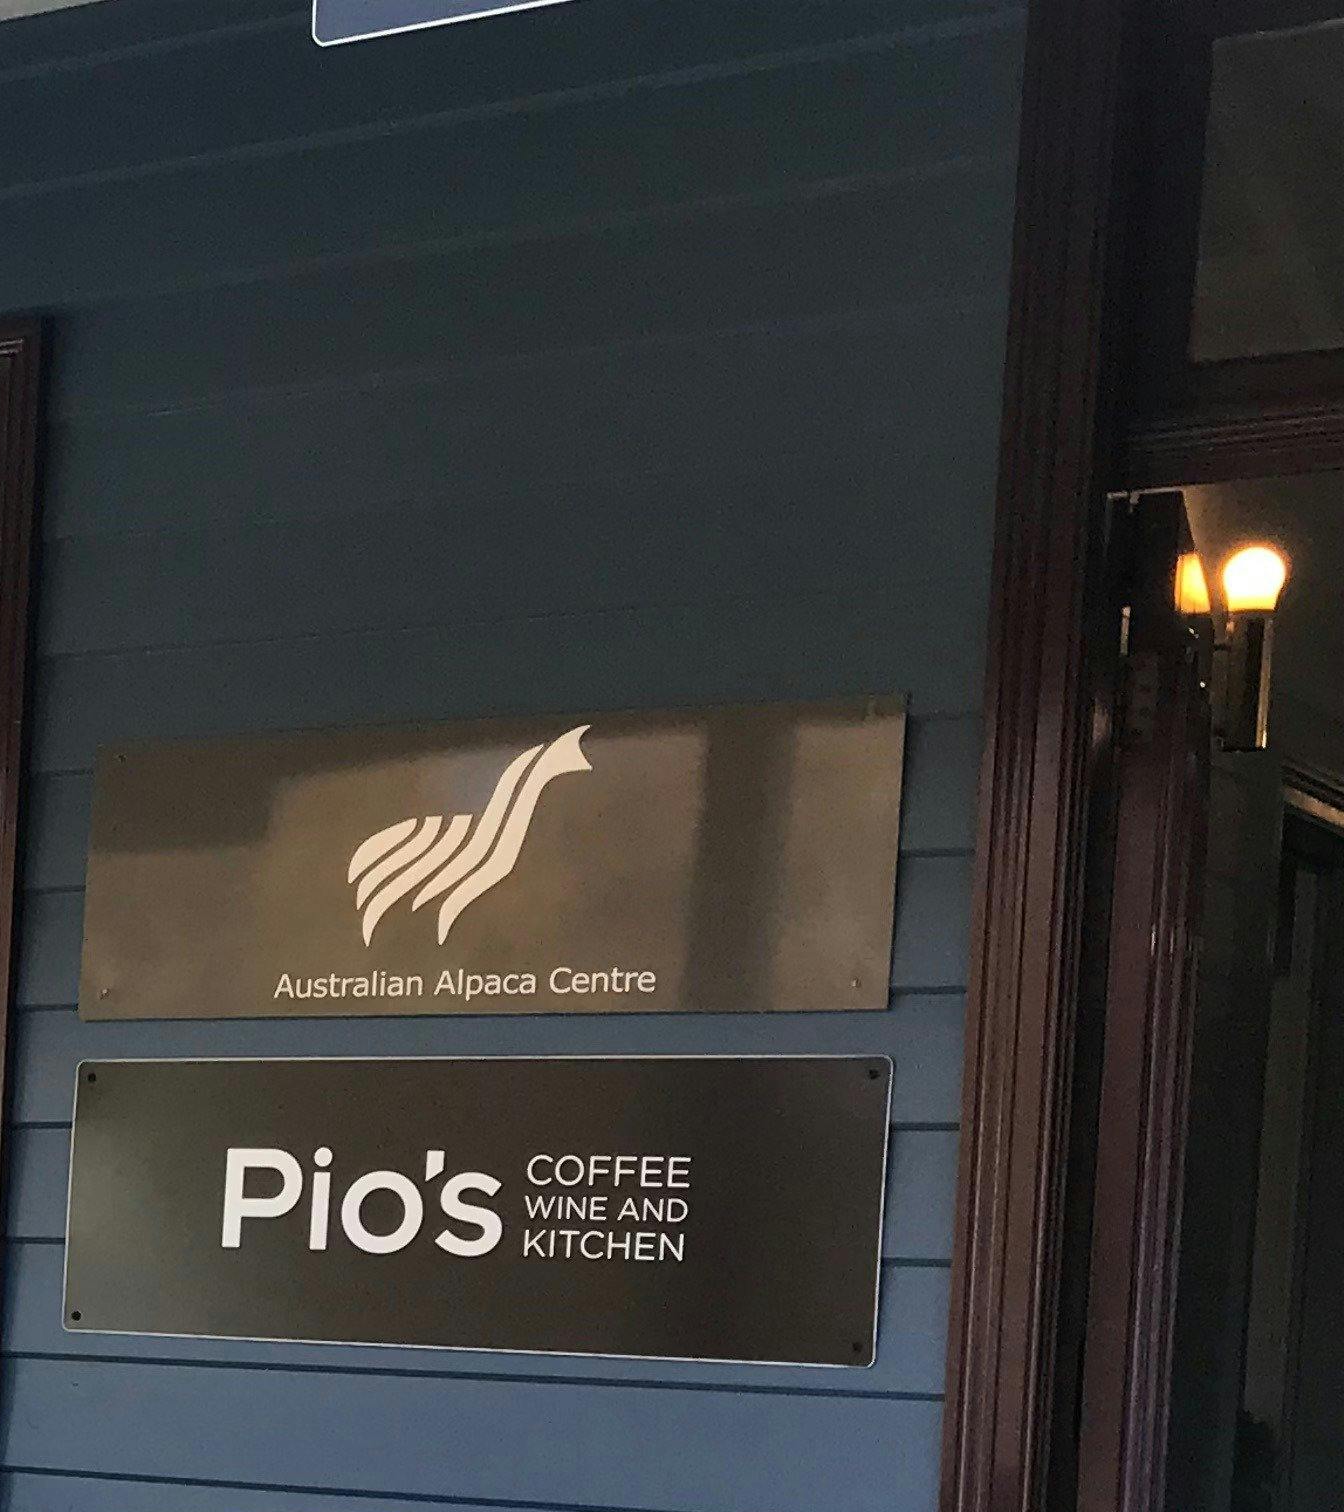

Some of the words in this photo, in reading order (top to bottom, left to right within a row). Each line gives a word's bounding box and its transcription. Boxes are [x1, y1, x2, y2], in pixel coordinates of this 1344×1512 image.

[273, 971, 423, 999] Australian
[433, 968, 537, 1001] Alpaca
[548, 966, 656, 994] Centre
[525, 1154, 692, 1189] COFFEE
[221, 1146, 503, 1258] Pio's
[525, 1196, 608, 1221] WINE
[617, 1197, 689, 1223] AND
[523, 1229, 685, 1263] KITCHEN
